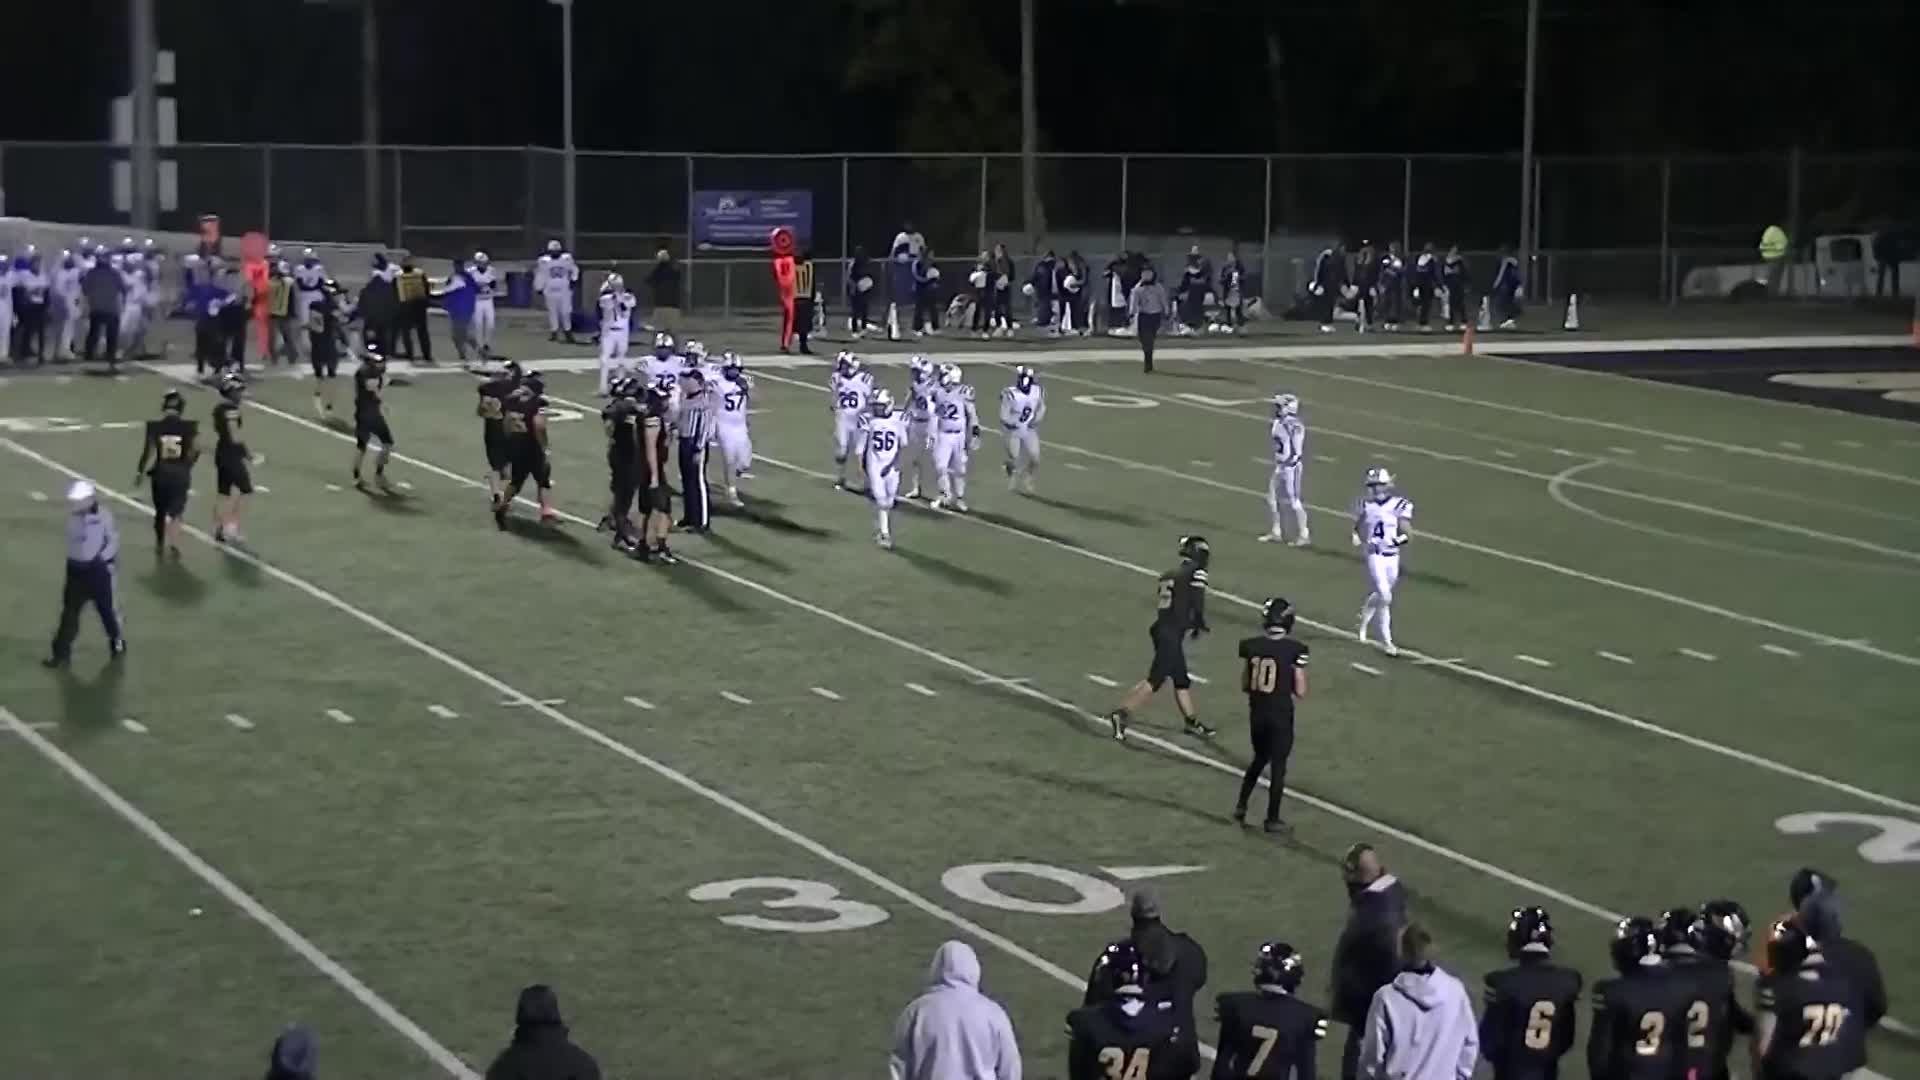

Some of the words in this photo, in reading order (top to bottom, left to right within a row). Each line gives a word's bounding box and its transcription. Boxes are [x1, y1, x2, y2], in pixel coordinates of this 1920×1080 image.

[724, 391, 745, 412] 57
[837, 390, 859, 409] 26
[872, 430, 895, 451] 56
[1373, 520, 1386, 540] 4
[1249, 656, 1279, 694] 10
[1524, 1000, 1557, 1050] 6
[1635, 1011, 1666, 1057] 3
[1686, 1000, 1710, 1048] 2
[1799, 1004, 1848, 1048] 70
[1097, 1046, 1151, 1080] 34
[1246, 1025, 1279, 1077] 7
